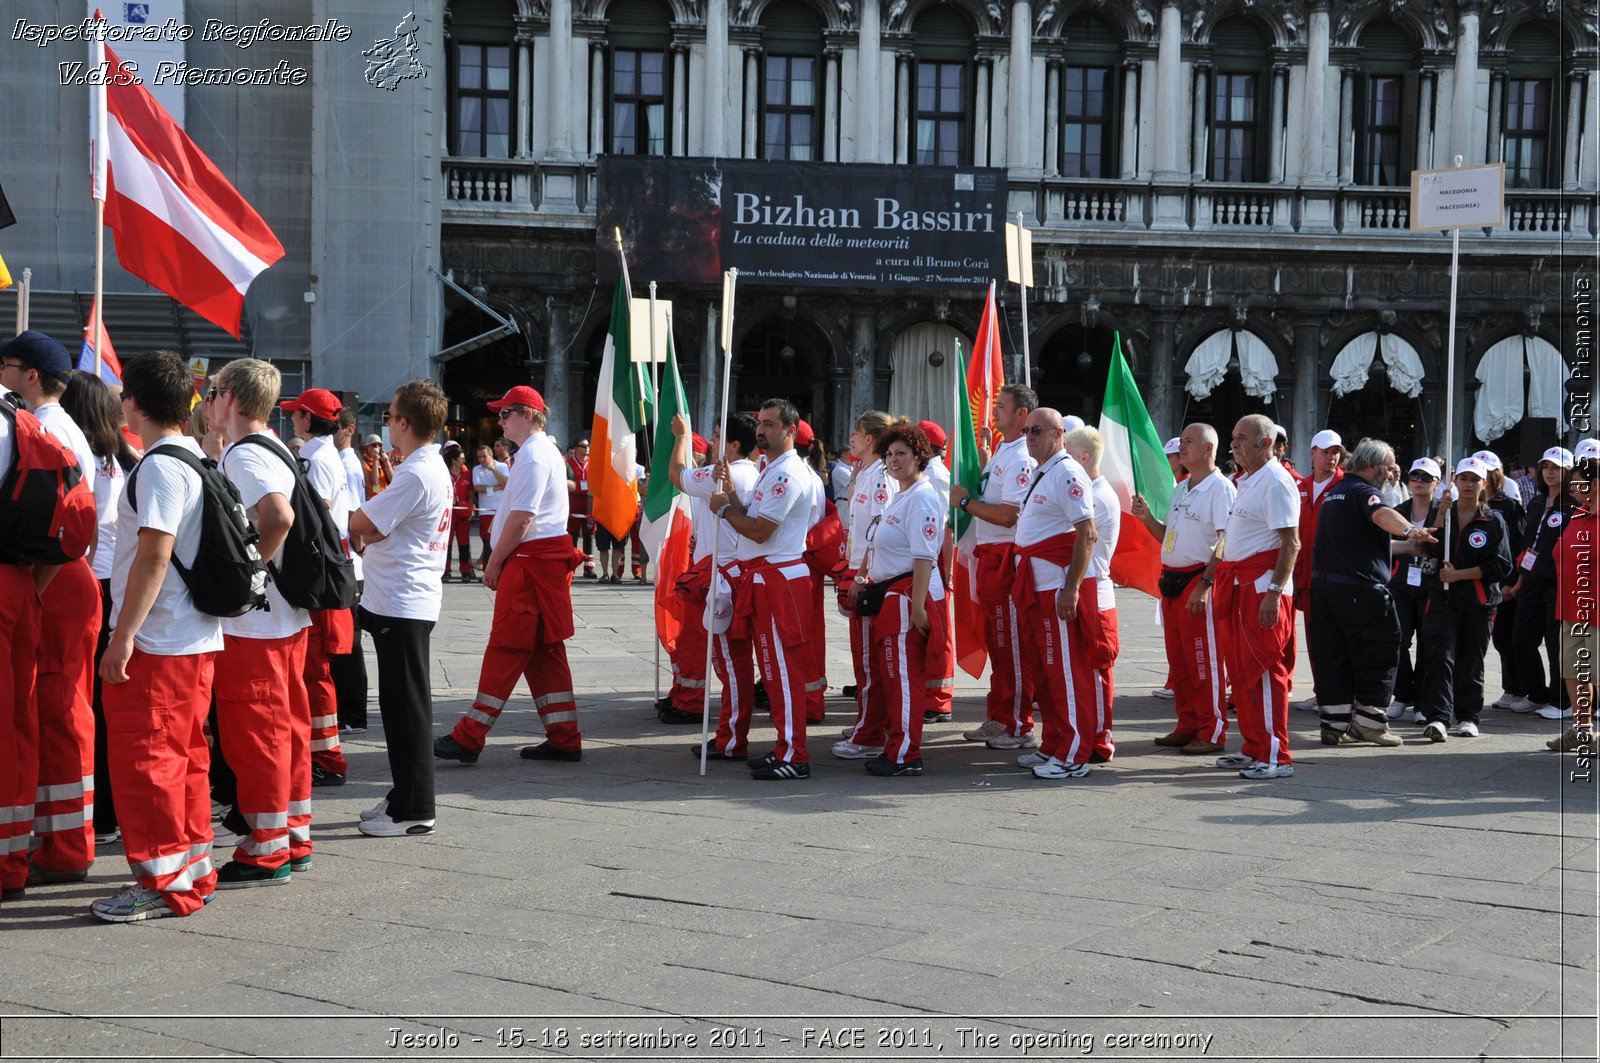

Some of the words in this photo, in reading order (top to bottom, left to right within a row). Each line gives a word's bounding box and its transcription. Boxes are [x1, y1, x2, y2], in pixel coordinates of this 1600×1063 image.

[733, 193, 861, 229] Bizhan
[873, 197, 995, 232] Bassiri
[1436, 202, 1480, 211] (MACEDONIA)
[733, 230, 752, 244] La
[756, 231, 806, 246] caduta
[810, 233, 843, 247] delle
[847, 236, 910, 250] meteoriti
[875, 257, 882, 266] a
[885, 257, 910, 266] cura
[913, 256, 923, 267] di
[926, 256, 961, 268] Bruno
[963, 257, 989, 269] Corà
[757, 269, 802, 279] Archeologico
[804, 270, 839, 279] Nazionale
[840, 271, 848, 279] di
[849, 272, 876, 280] Venezia
[894, 273, 920, 282] Giugno
[936, 275, 972, 283] Novembre
[972, 276, 989, 284] 2011
[760, 634, 768, 647] CROCE
